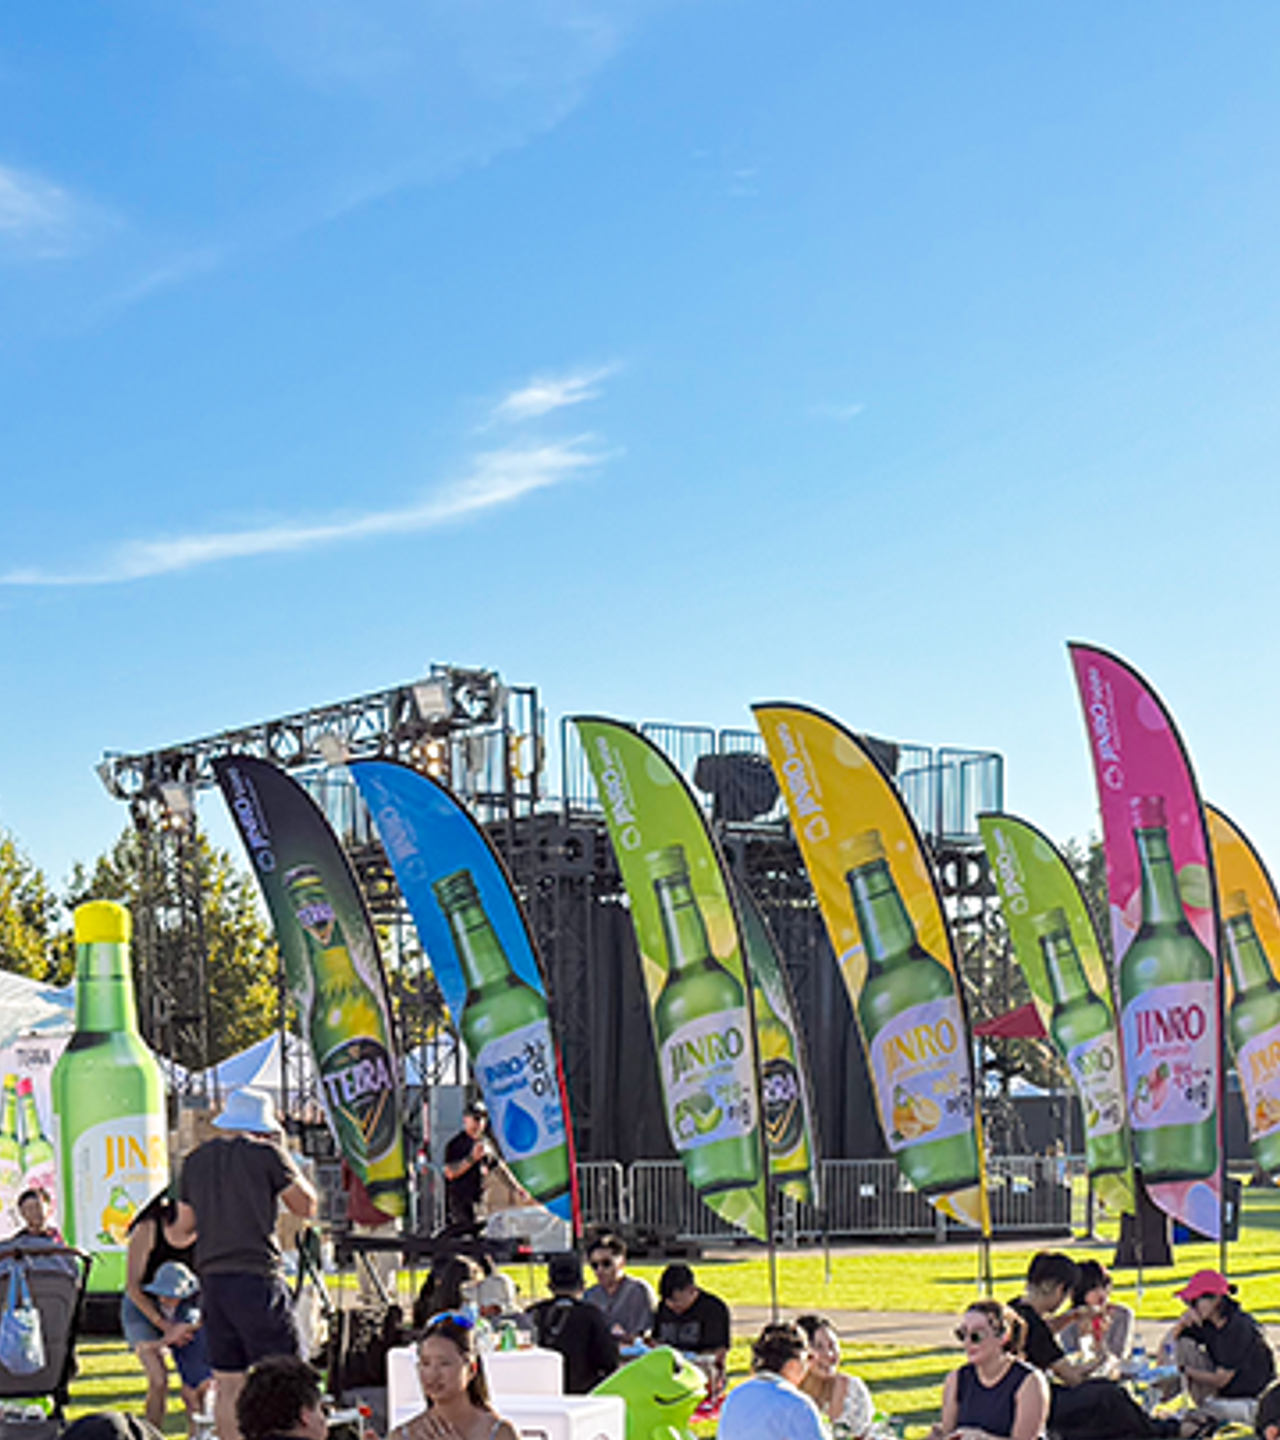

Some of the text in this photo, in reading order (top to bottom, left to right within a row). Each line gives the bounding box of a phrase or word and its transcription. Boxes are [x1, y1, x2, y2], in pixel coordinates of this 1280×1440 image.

[1089, 704, 1121, 762] JINRO
[601, 769, 635, 825] JINRO
[782, 757, 822, 817] JINRO
[235, 798, 269, 848] JINRO
[671, 1026, 745, 1082] JINRO
[882, 1017, 958, 1084] JINRO
[1136, 1003, 1207, 1056] JINRO
[322, 1052, 392, 1108] TERRA
